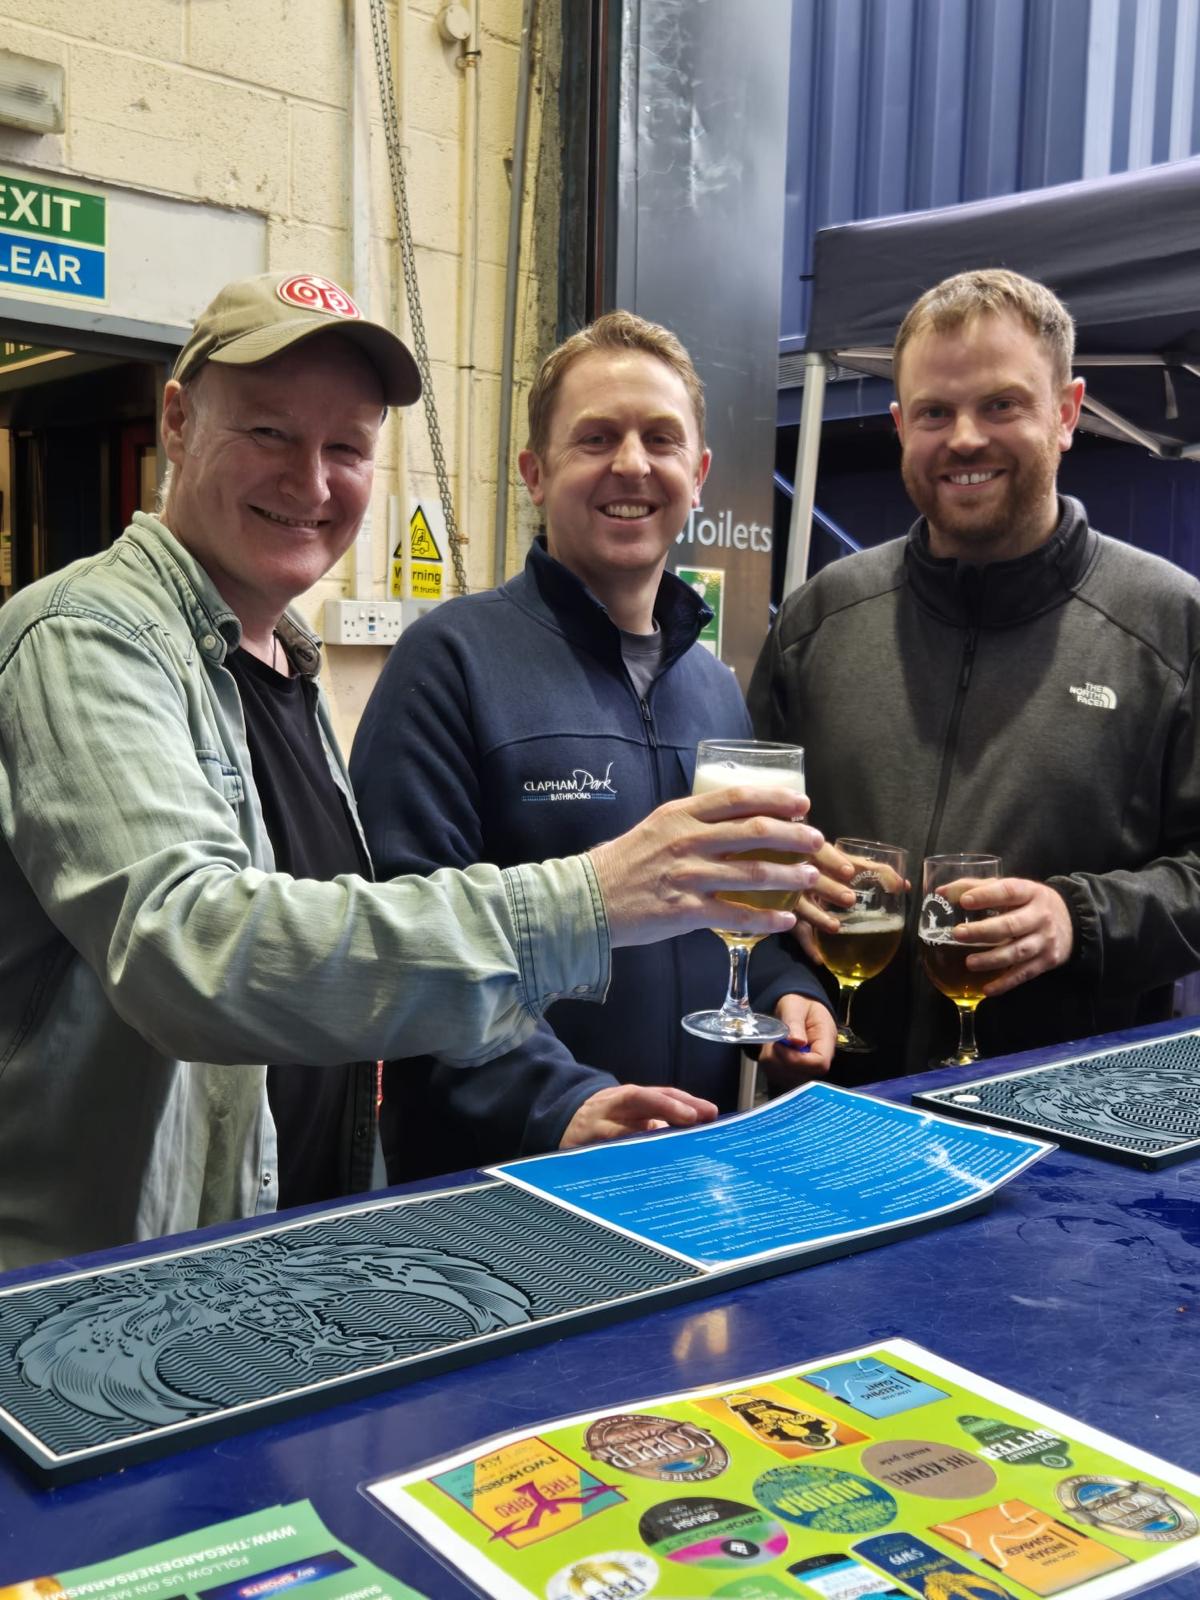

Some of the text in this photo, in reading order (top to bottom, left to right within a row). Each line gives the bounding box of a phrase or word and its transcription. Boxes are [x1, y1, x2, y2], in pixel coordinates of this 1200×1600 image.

[0, 183, 81, 232] XIT
[687, 507, 772, 552] Toilets
[394, 566, 441, 586] Wrning
[1069, 686, 1102, 700] NORTH
[523, 761, 617, 794] CLAPHAM Park
[550, 792, 591, 801] BATHROOMS
[865, 1378, 894, 1391] GIANT
[608, 1426, 715, 1468] COPPER
[977, 1428, 1059, 1460] BITTER
[521, 1455, 559, 1476] TWO
[659, 1458, 726, 1482] PALMERS
[880, 1453, 977, 1486] THE KERNEL
[539, 1474, 579, 1498] FIRE
[493, 1497, 534, 1518] BIRD
[775, 1478, 873, 1516] AURORA
[672, 1511, 720, 1530] CRUSH
[888, 1548, 925, 1565] SW19
[1005, 1535, 1055, 1557] SUMMER
[1025, 1542, 1067, 1561] INDIAN
[187, 1556, 249, 1581] FOLLOW
[135, 1581, 160, 1595] ON
[161, 1574, 183, 1588] US
